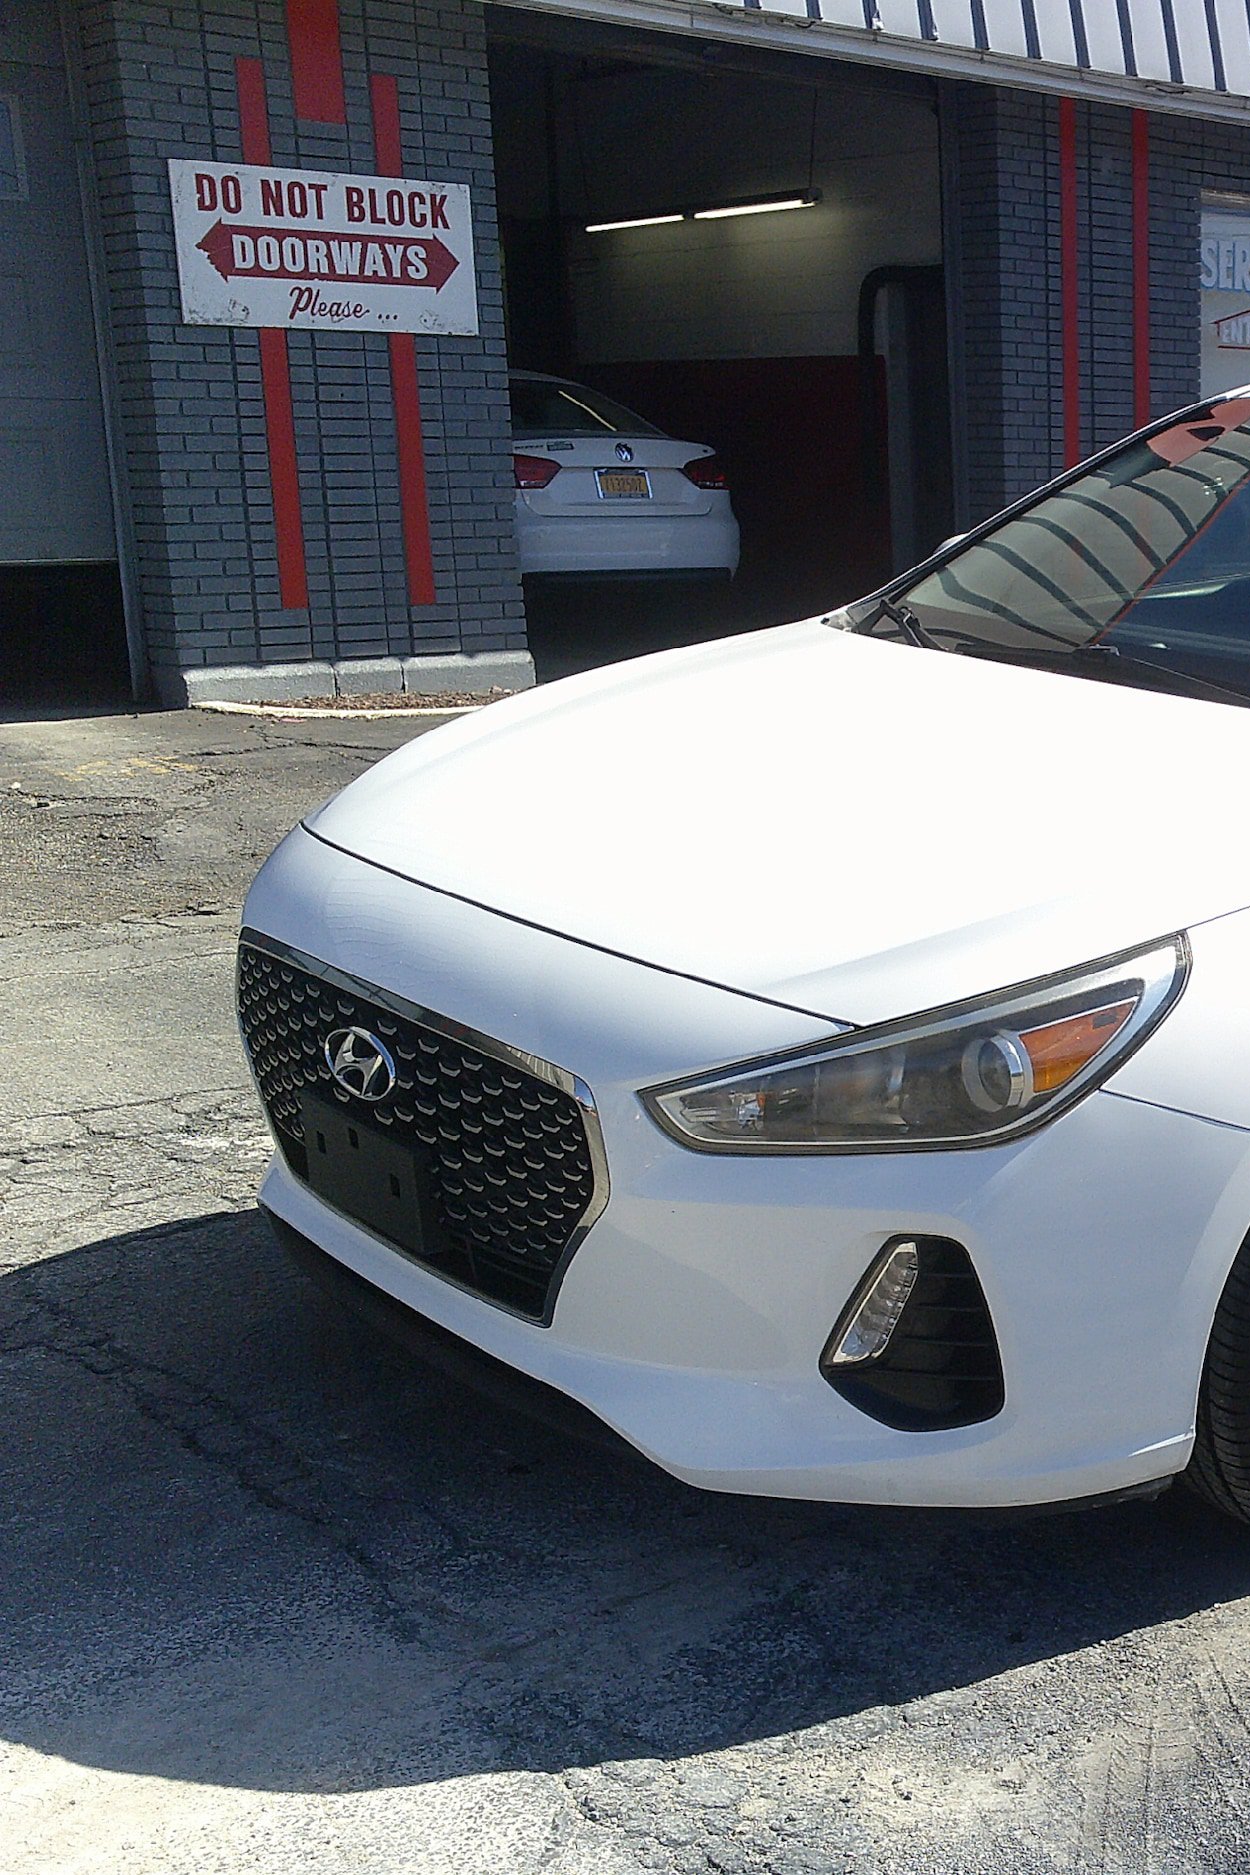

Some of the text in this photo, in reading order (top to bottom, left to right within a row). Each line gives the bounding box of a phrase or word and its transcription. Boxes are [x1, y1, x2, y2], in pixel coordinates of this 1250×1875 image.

[195, 173, 451, 230] DO NOT BLOCK
[231, 234, 428, 280] DOORWAYS
[288, 286, 370, 320] Please
